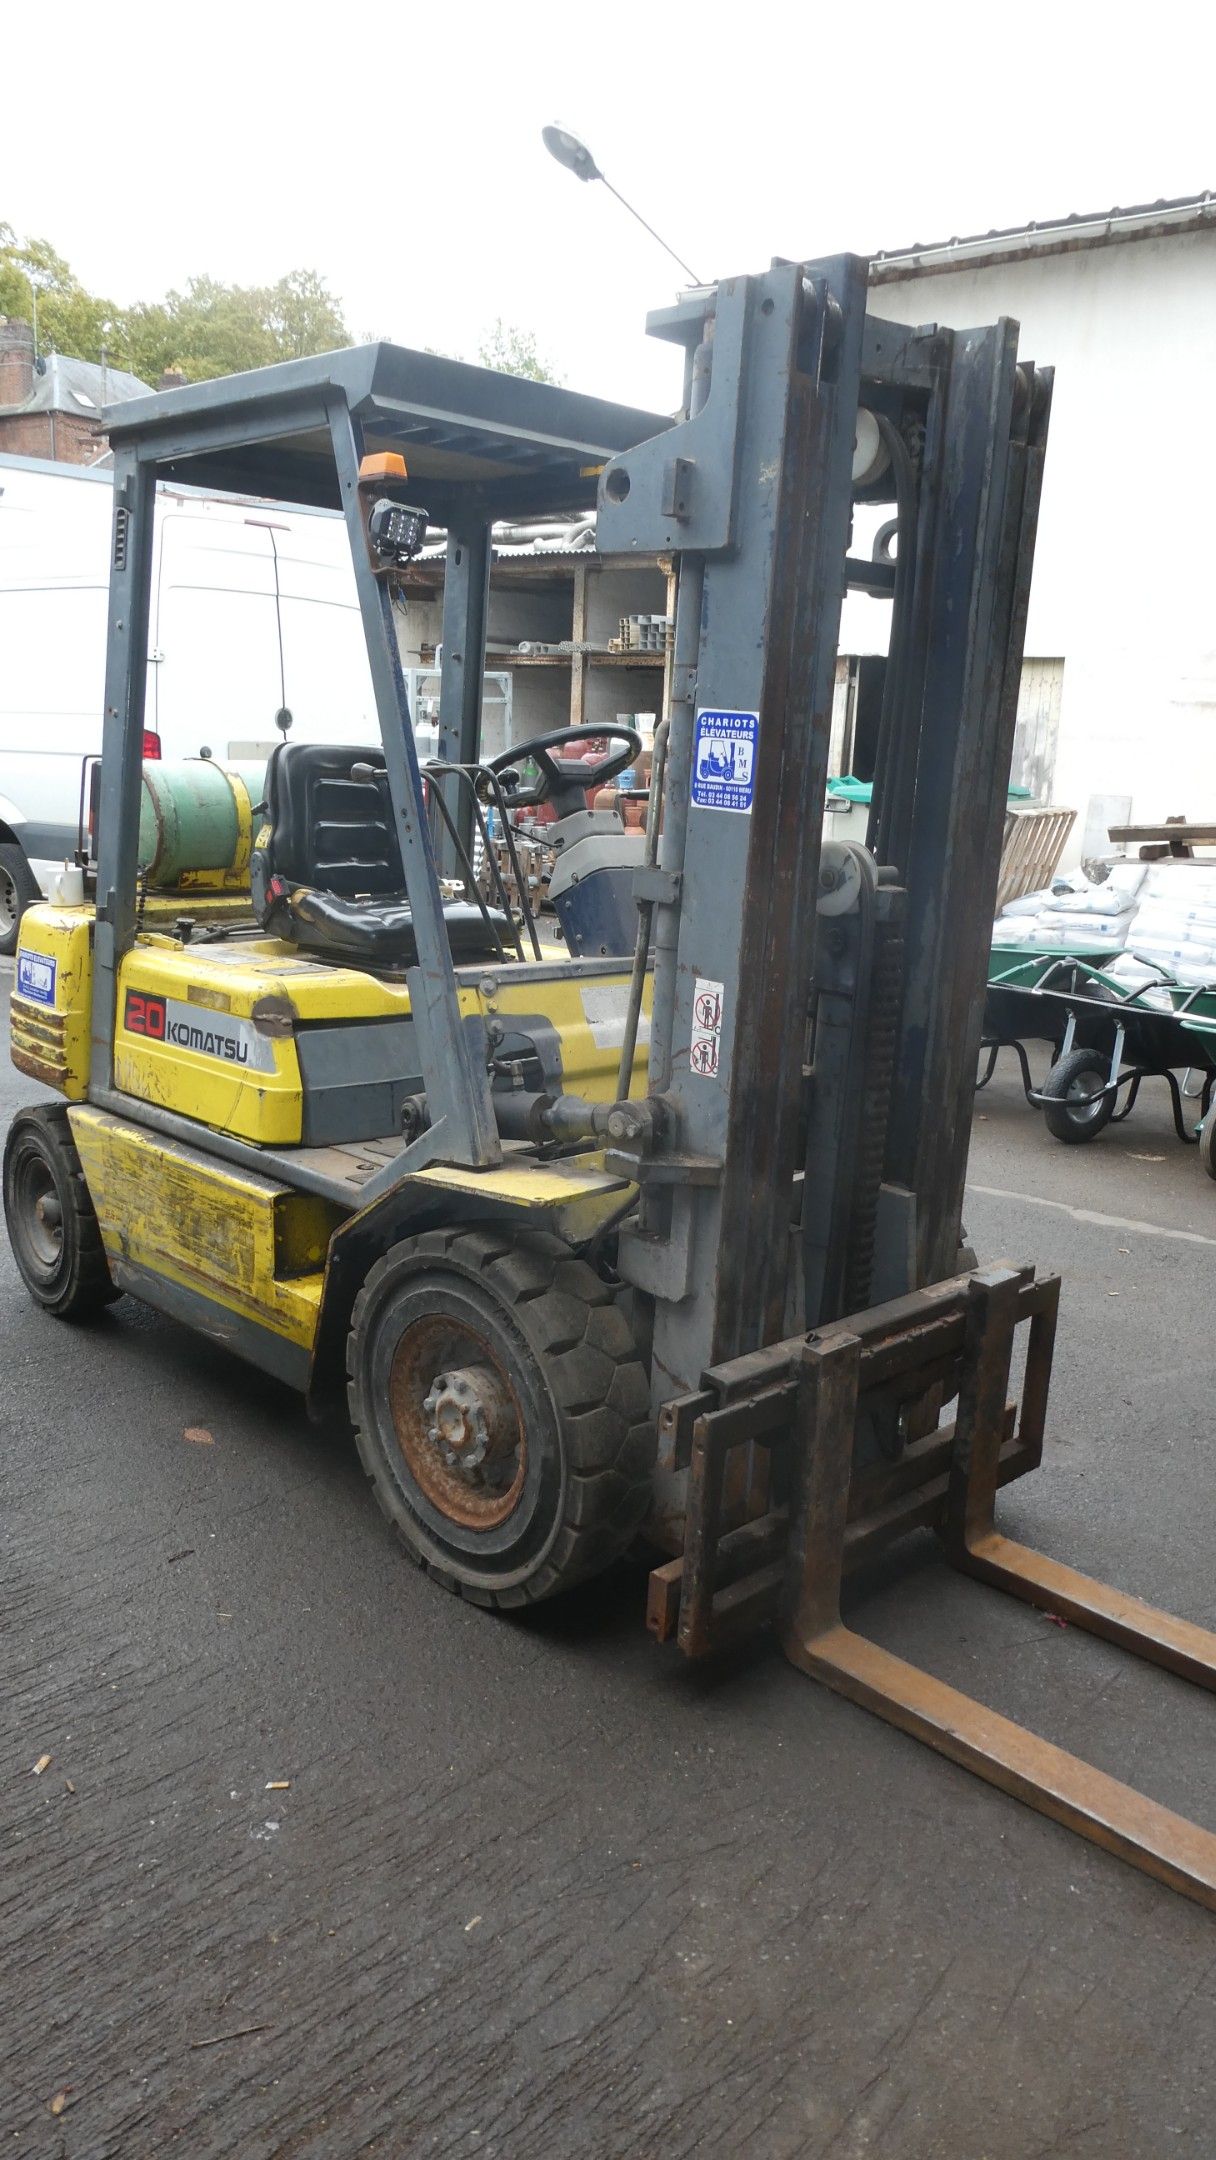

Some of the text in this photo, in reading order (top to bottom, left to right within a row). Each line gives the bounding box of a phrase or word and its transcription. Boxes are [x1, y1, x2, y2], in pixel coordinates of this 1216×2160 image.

[701, 717, 755, 729] CHARIOTS
[700, 726, 754, 739] ÉLÉVATEURS
[127, 995, 248, 1063] 20 KOMATSU
